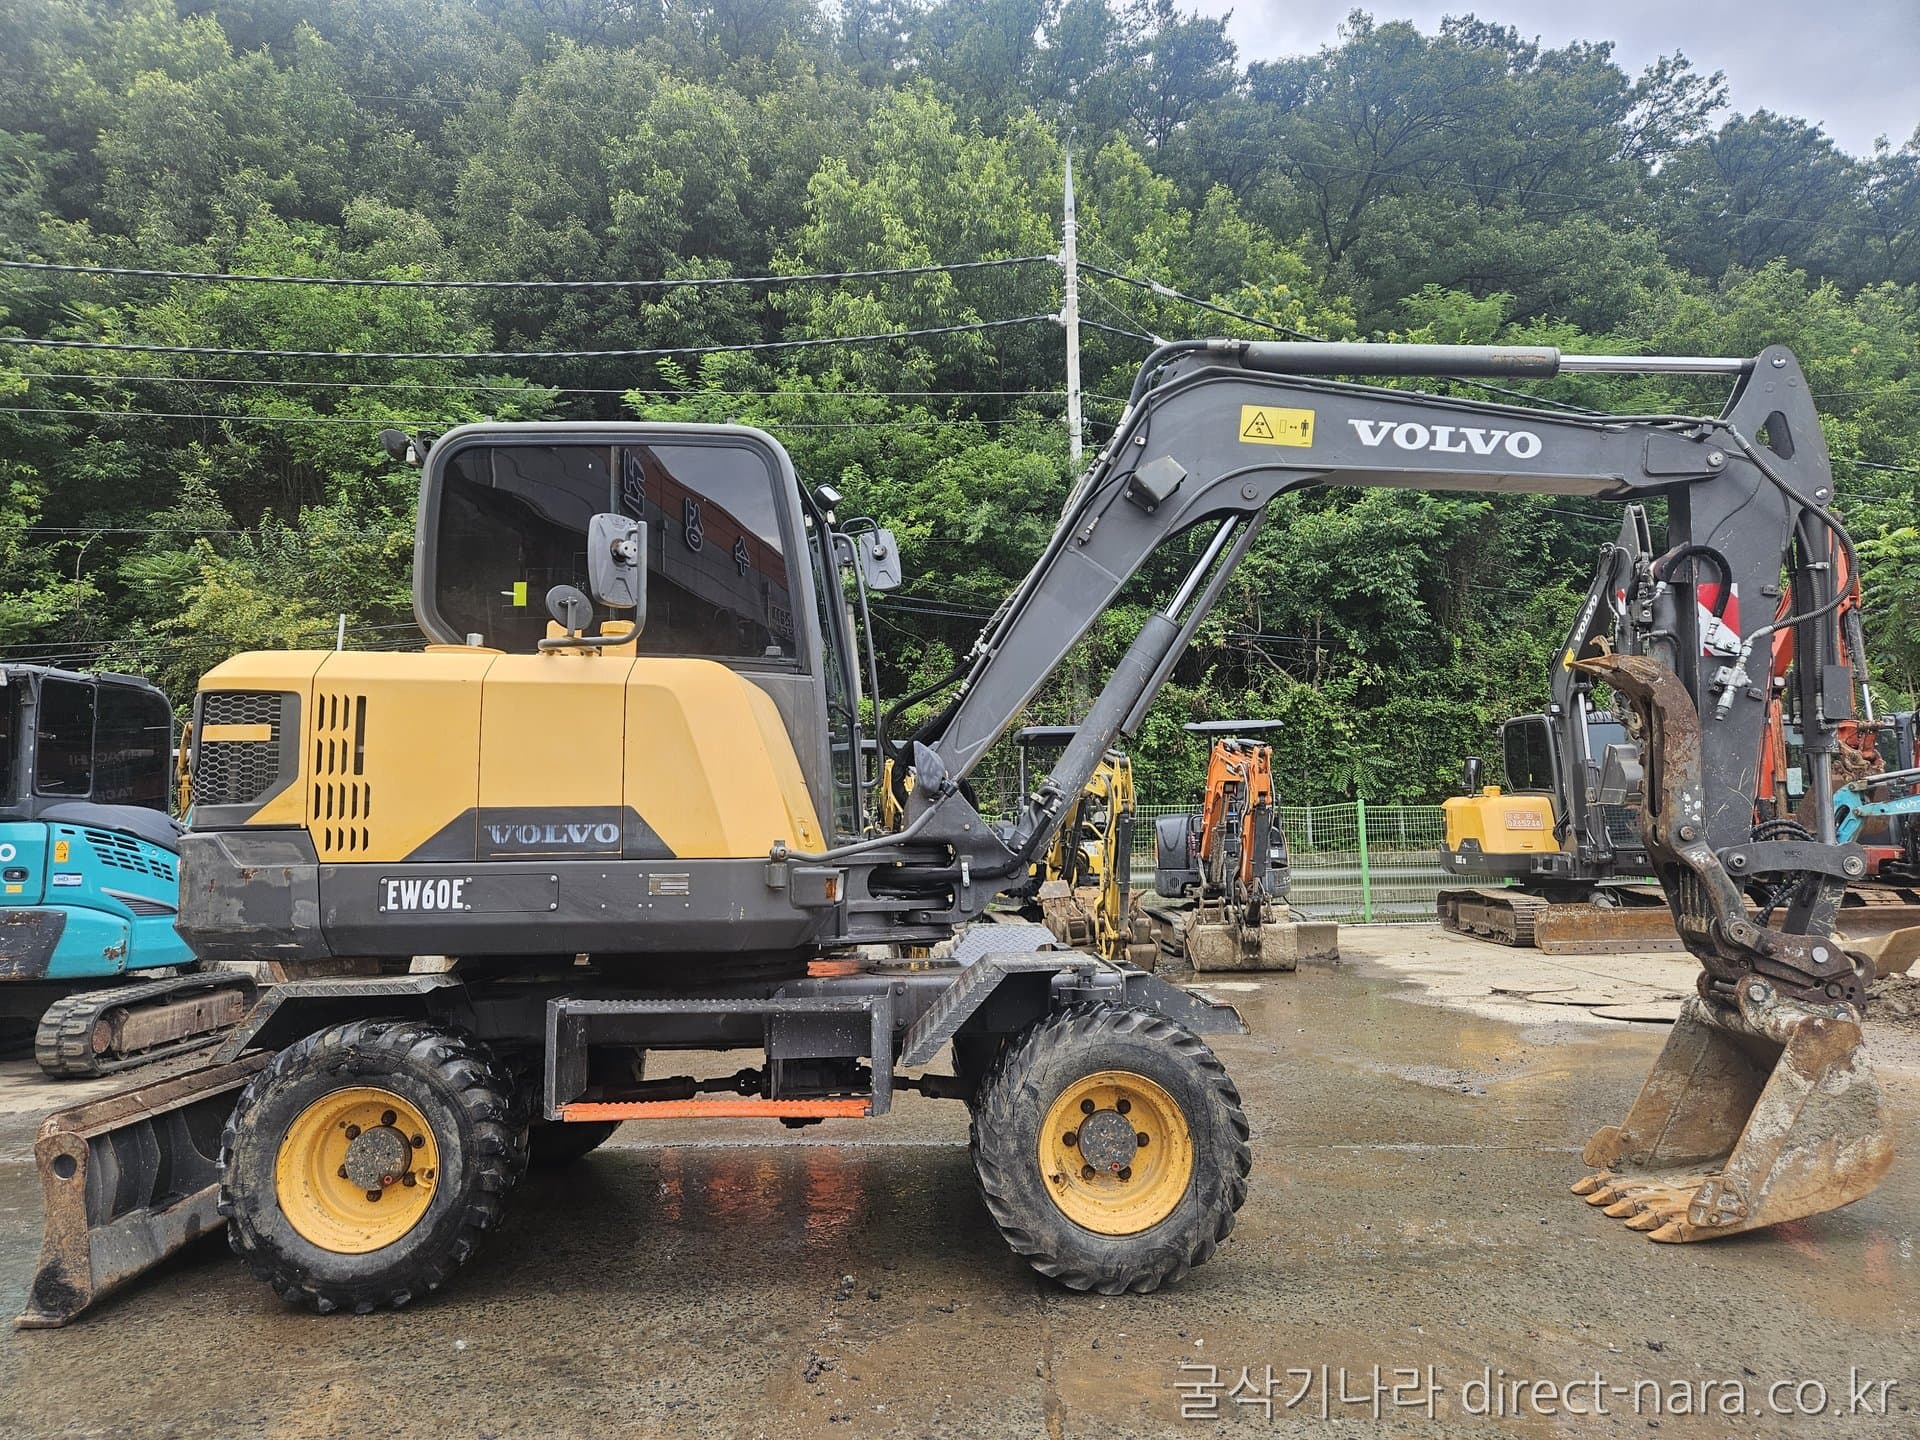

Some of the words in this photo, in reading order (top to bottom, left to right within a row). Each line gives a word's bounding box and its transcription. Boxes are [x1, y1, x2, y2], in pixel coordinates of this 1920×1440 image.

[1347, 418, 1543, 459] VOLVO
[1574, 594, 1598, 642] VOLVO
[483, 822, 619, 845] VOLVO
[386, 878, 465, 911] EW60E
